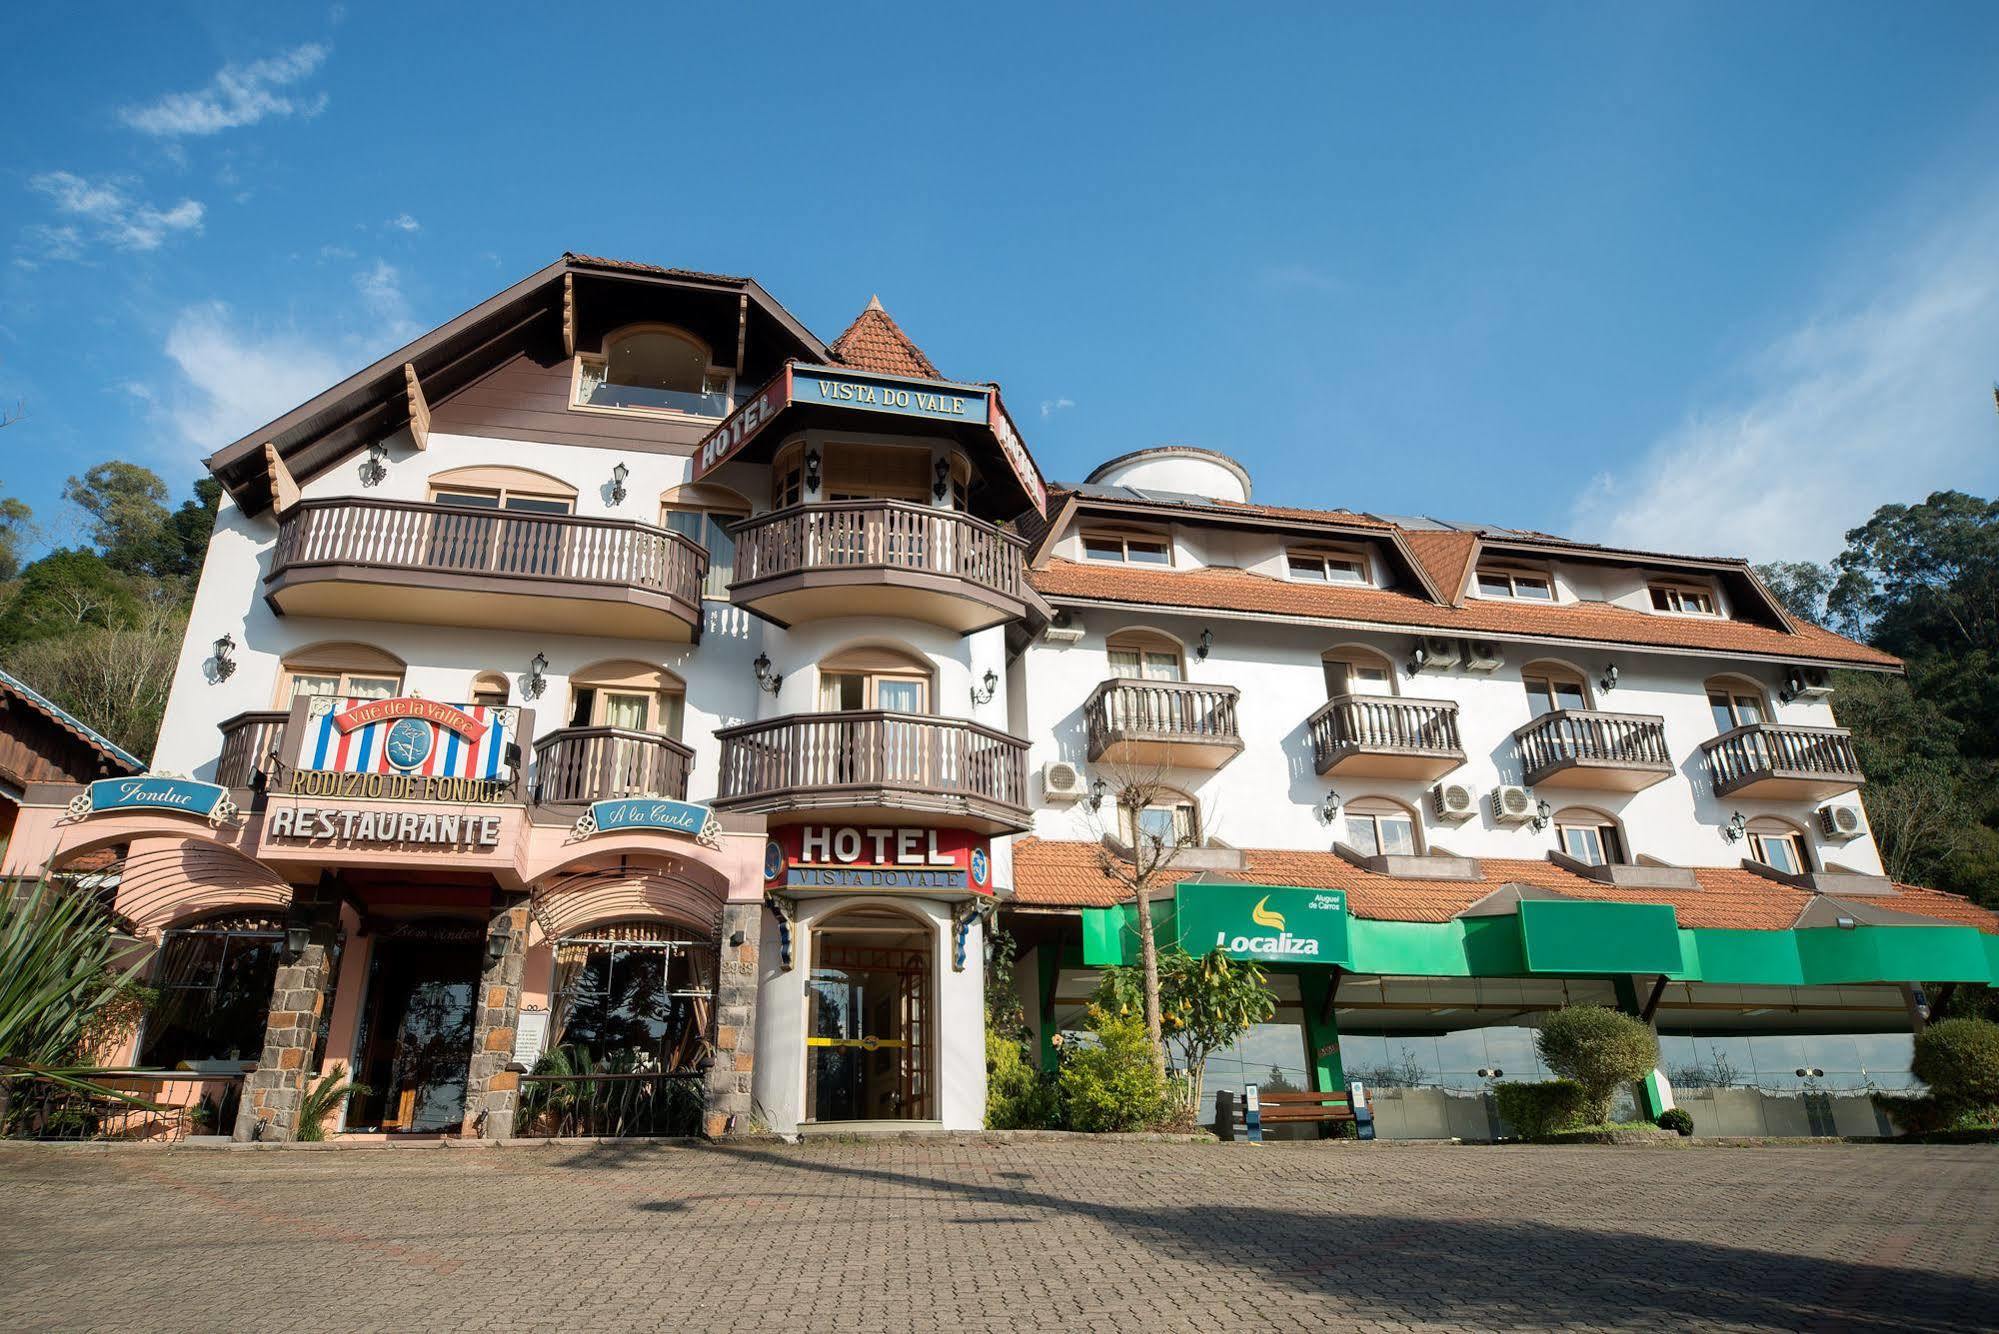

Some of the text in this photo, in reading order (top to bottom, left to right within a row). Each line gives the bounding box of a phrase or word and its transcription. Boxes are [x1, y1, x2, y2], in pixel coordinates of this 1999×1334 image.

[818, 380, 965, 415] VISTA DO VALE
[702, 394, 775, 471] HOTEL
[349, 705, 380, 723] Vue
[385, 702, 406, 714] de
[409, 701, 425, 715] la
[119, 782, 192, 804] Fondue
[290, 770, 506, 803] RODIZIO DE FONDUE
[271, 807, 501, 846] RESTAURANTE
[609, 804, 695, 827] A la Carte
[802, 826, 956, 865] HOTEL
[800, 869, 961, 887] VISTA DO VALE
[1308, 901, 1340, 911] de Carros
[1315, 894, 1340, 904] Aluguel
[1216, 931, 1319, 955] Localiza
